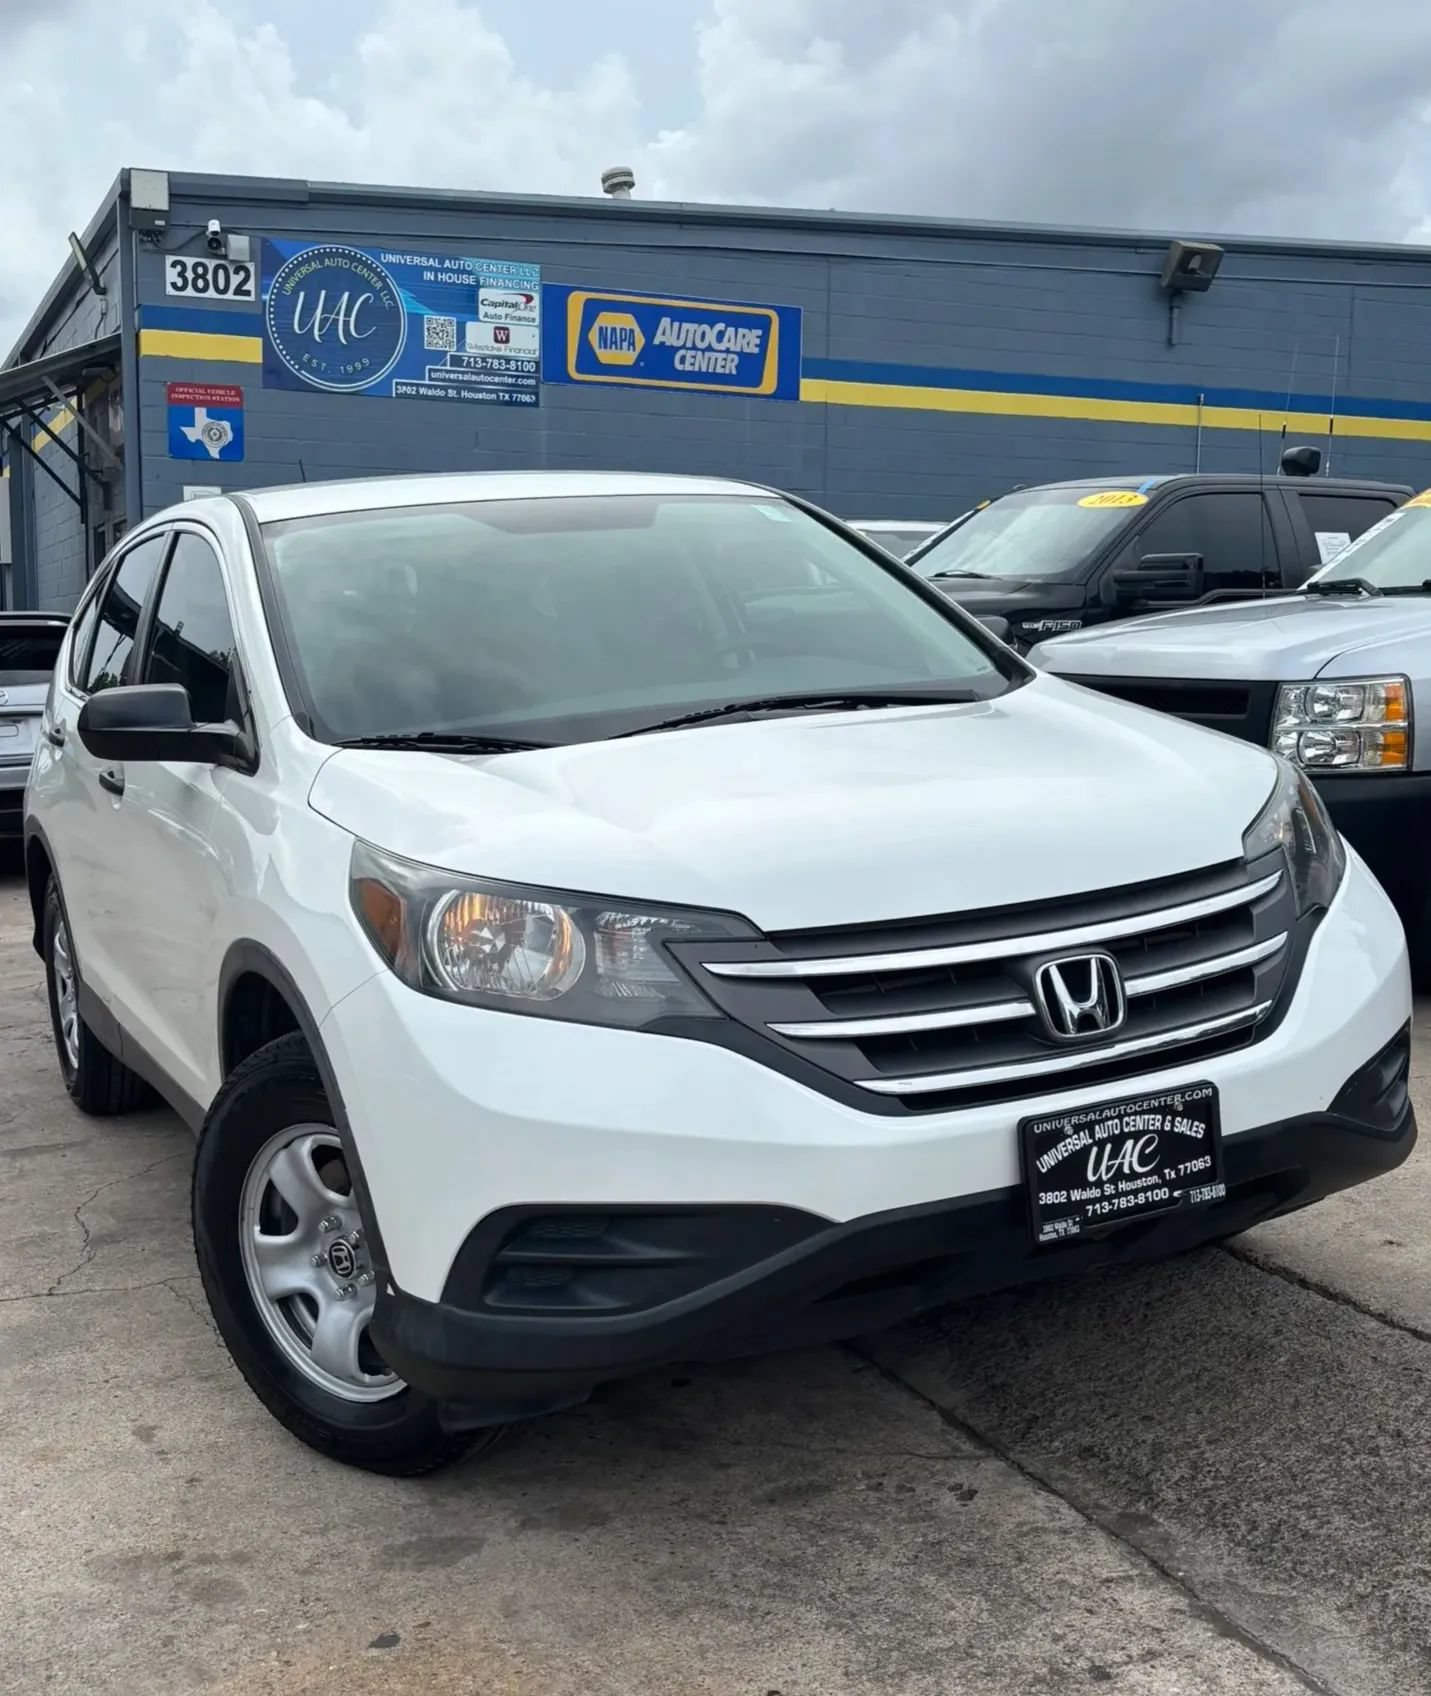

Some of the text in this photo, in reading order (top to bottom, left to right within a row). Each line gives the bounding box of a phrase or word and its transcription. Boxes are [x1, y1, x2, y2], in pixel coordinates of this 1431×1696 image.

[381, 253, 539, 277] UNIVERSAL AUTO CENTER LLC
[170, 259, 252, 297] 3802
[282, 258, 395, 311] UNIVERSAL AUTO CENTER LLC
[423, 270, 539, 291] IN HOUSE FINANCING
[293, 289, 377, 345] UAC
[483, 311, 537, 324] Auto Finance
[495, 329, 509, 341] W
[597, 325, 637, 352] NAPA
[302, 353, 370, 374] EST. 1999
[461, 356, 536, 372] 713-783-8100
[673, 348, 740, 376] CENTER
[430, 371, 536, 386] universalautocenter.com
[171, 393, 211, 401] INSPECTION
[175, 386, 236, 396] OFFICIAL VEHICLE
[418, 386, 446, 397] Waldo
[460, 390, 497, 400] Houston
[498, 392, 510, 401] TX
[1033, 1087, 1213, 1134] UNIVERSALAUTOCENTER.COM
[1036, 1114, 1206, 1174] UNIVERSAL AUTO CENTER & SALES
[1086, 1133, 1160, 1182] UAC
[1038, 1155, 1212, 1206] 3802 Waldo St Houston, Tx 77063
[1085, 1187, 1170, 1217] 713-783-8100
[1189, 1183, 1226, 1203] 713-783-8100
